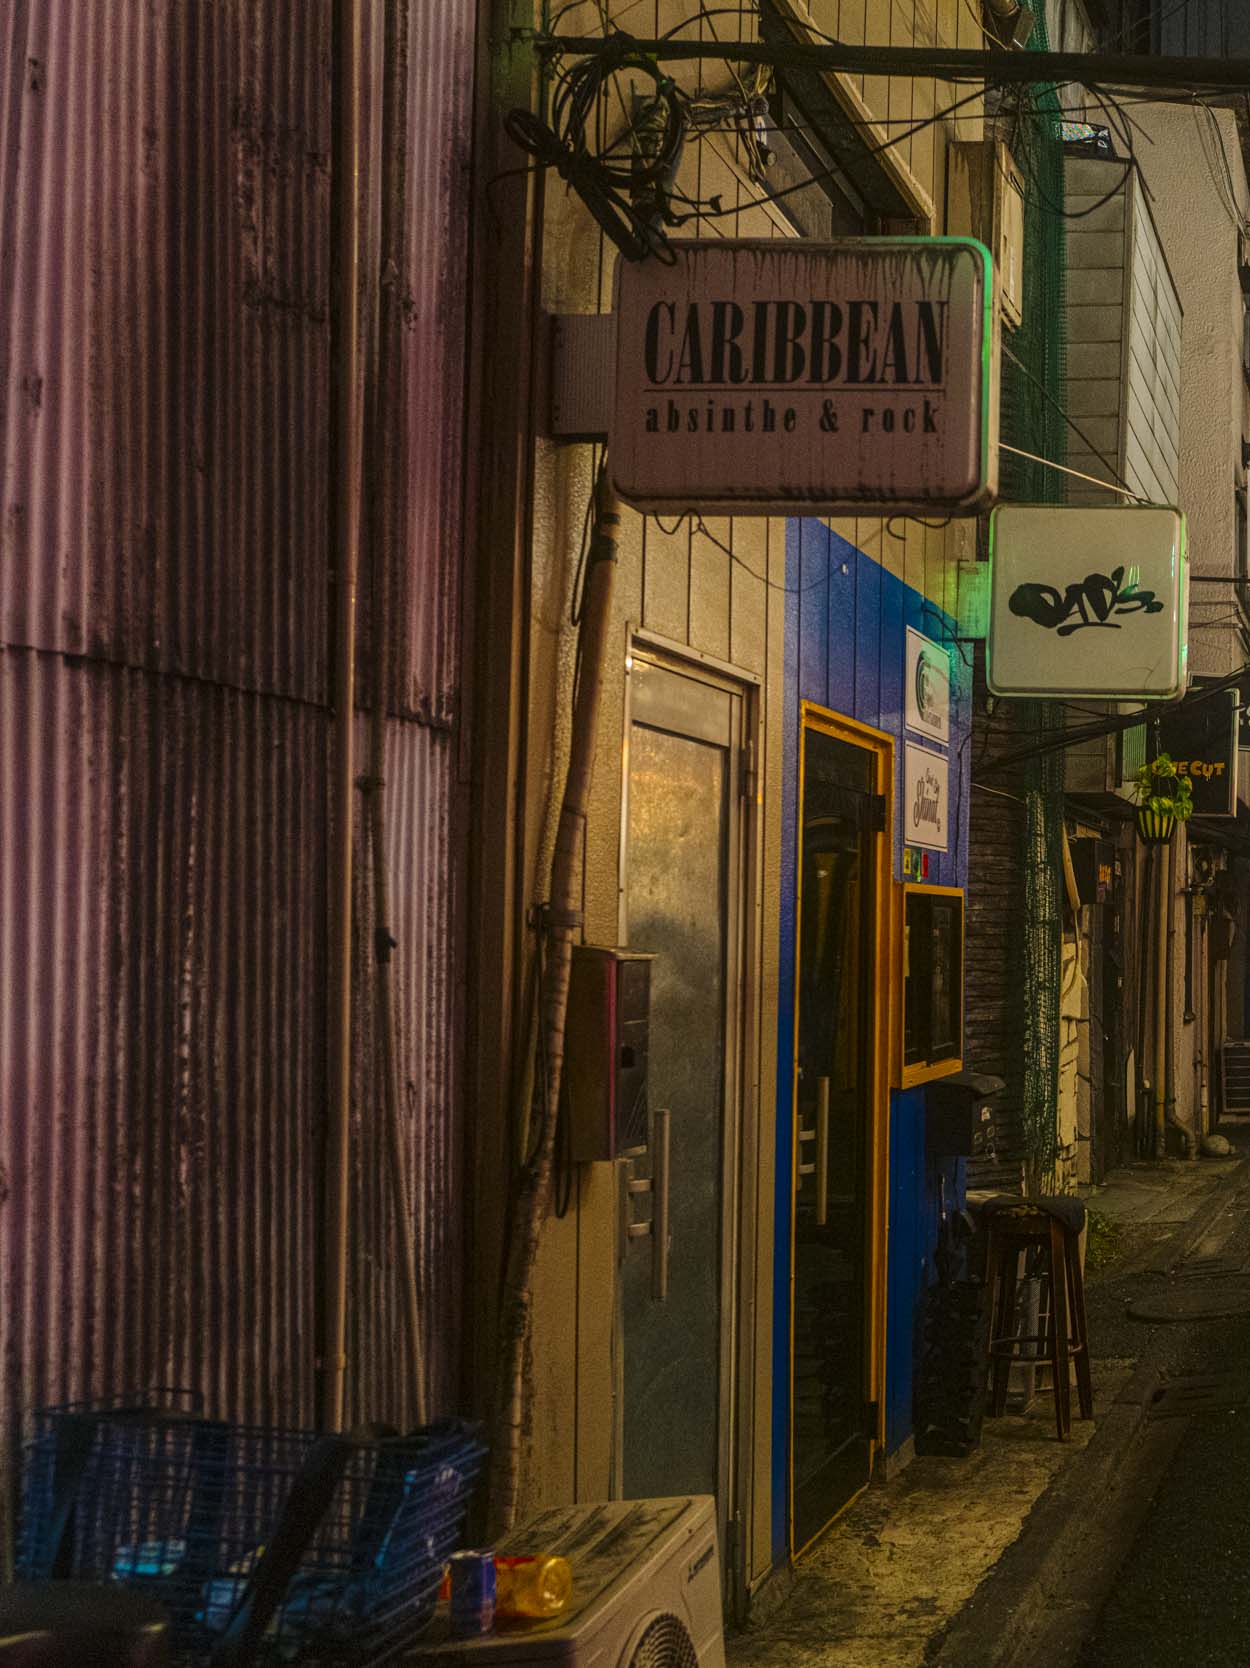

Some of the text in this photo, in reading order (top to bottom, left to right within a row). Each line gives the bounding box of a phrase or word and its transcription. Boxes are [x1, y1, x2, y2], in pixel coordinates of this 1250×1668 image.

[644, 300, 948, 385] CARIBBEAN
[646, 399, 938, 433] absinthe & rock
[1190, 760, 1225, 778] CUT
